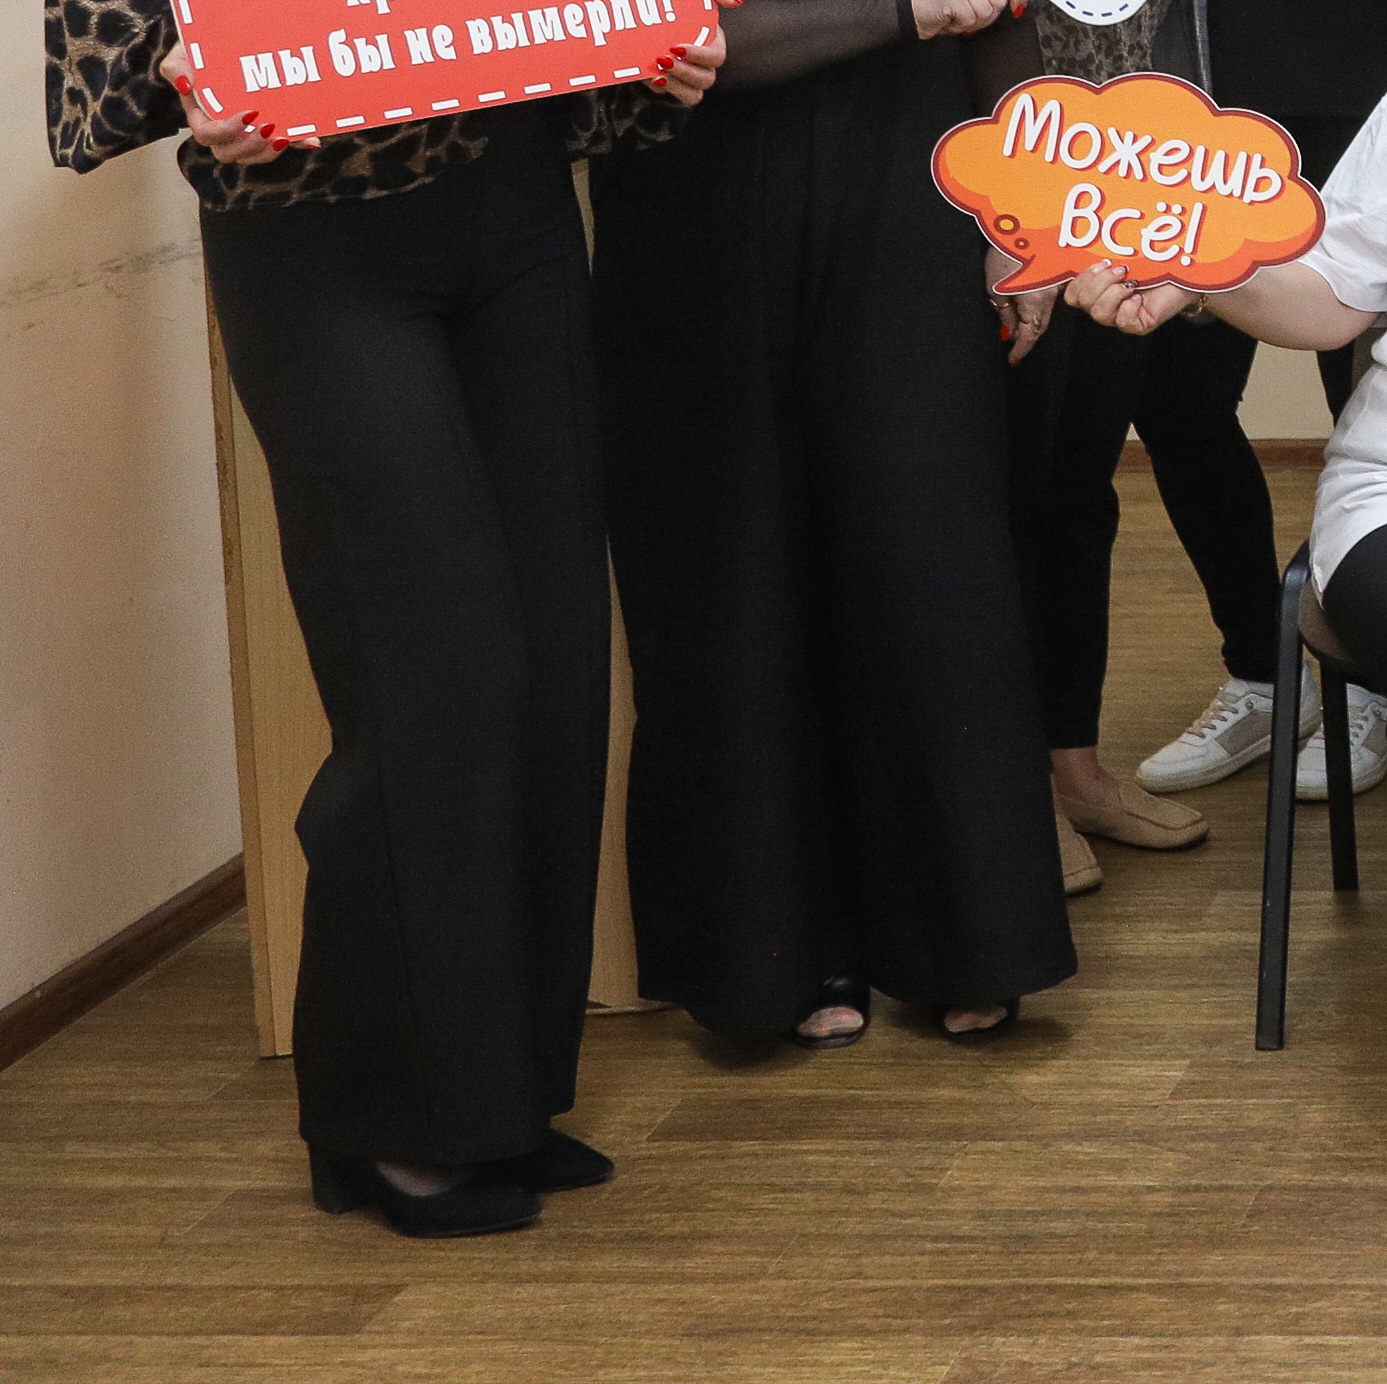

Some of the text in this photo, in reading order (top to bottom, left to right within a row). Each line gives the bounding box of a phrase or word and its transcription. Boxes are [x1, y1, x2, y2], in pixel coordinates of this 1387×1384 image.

[239, 45, 322, 92] мы
[328, 28, 397, 78] бы
[404, 21, 456, 65] не
[1002, 93, 1283, 204] Можешь
